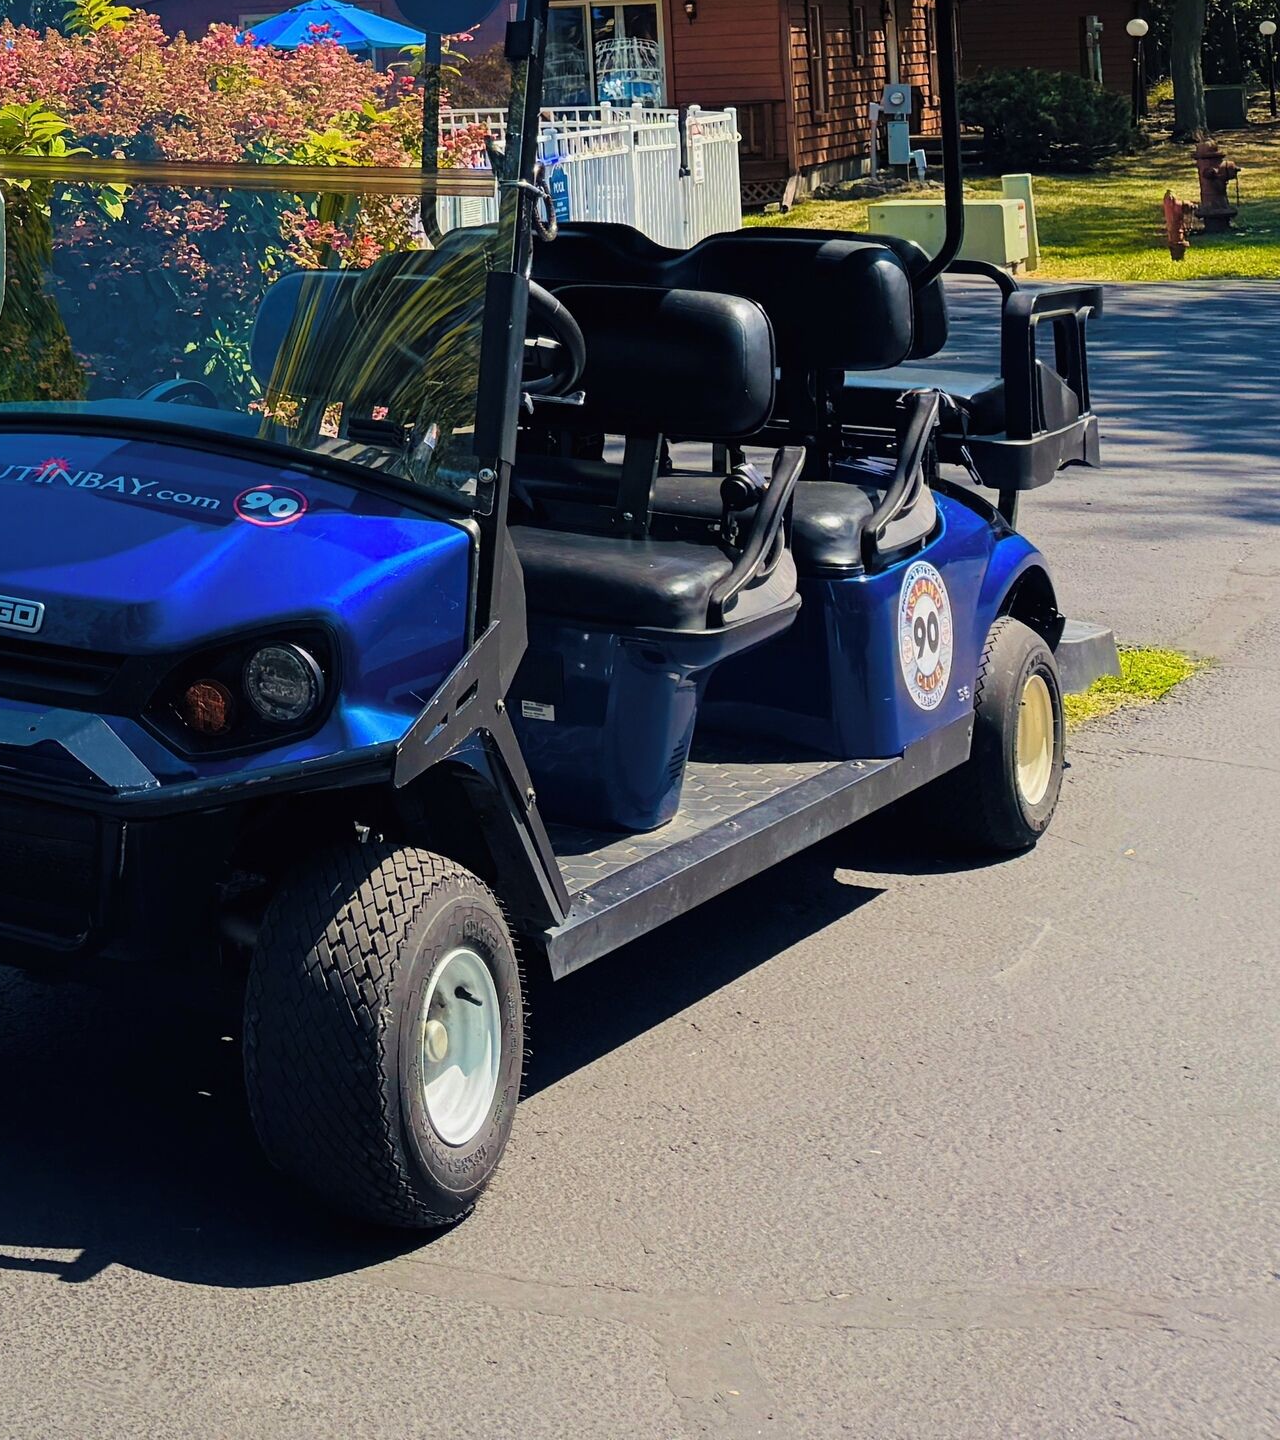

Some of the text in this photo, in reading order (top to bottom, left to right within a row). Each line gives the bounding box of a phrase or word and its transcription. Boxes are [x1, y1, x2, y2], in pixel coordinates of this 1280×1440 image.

[241, 491, 299, 518] 90
[906, 578, 944, 623] ISLAND
[913, 611, 940, 660] 90
[916, 664, 943, 692] CLUB
